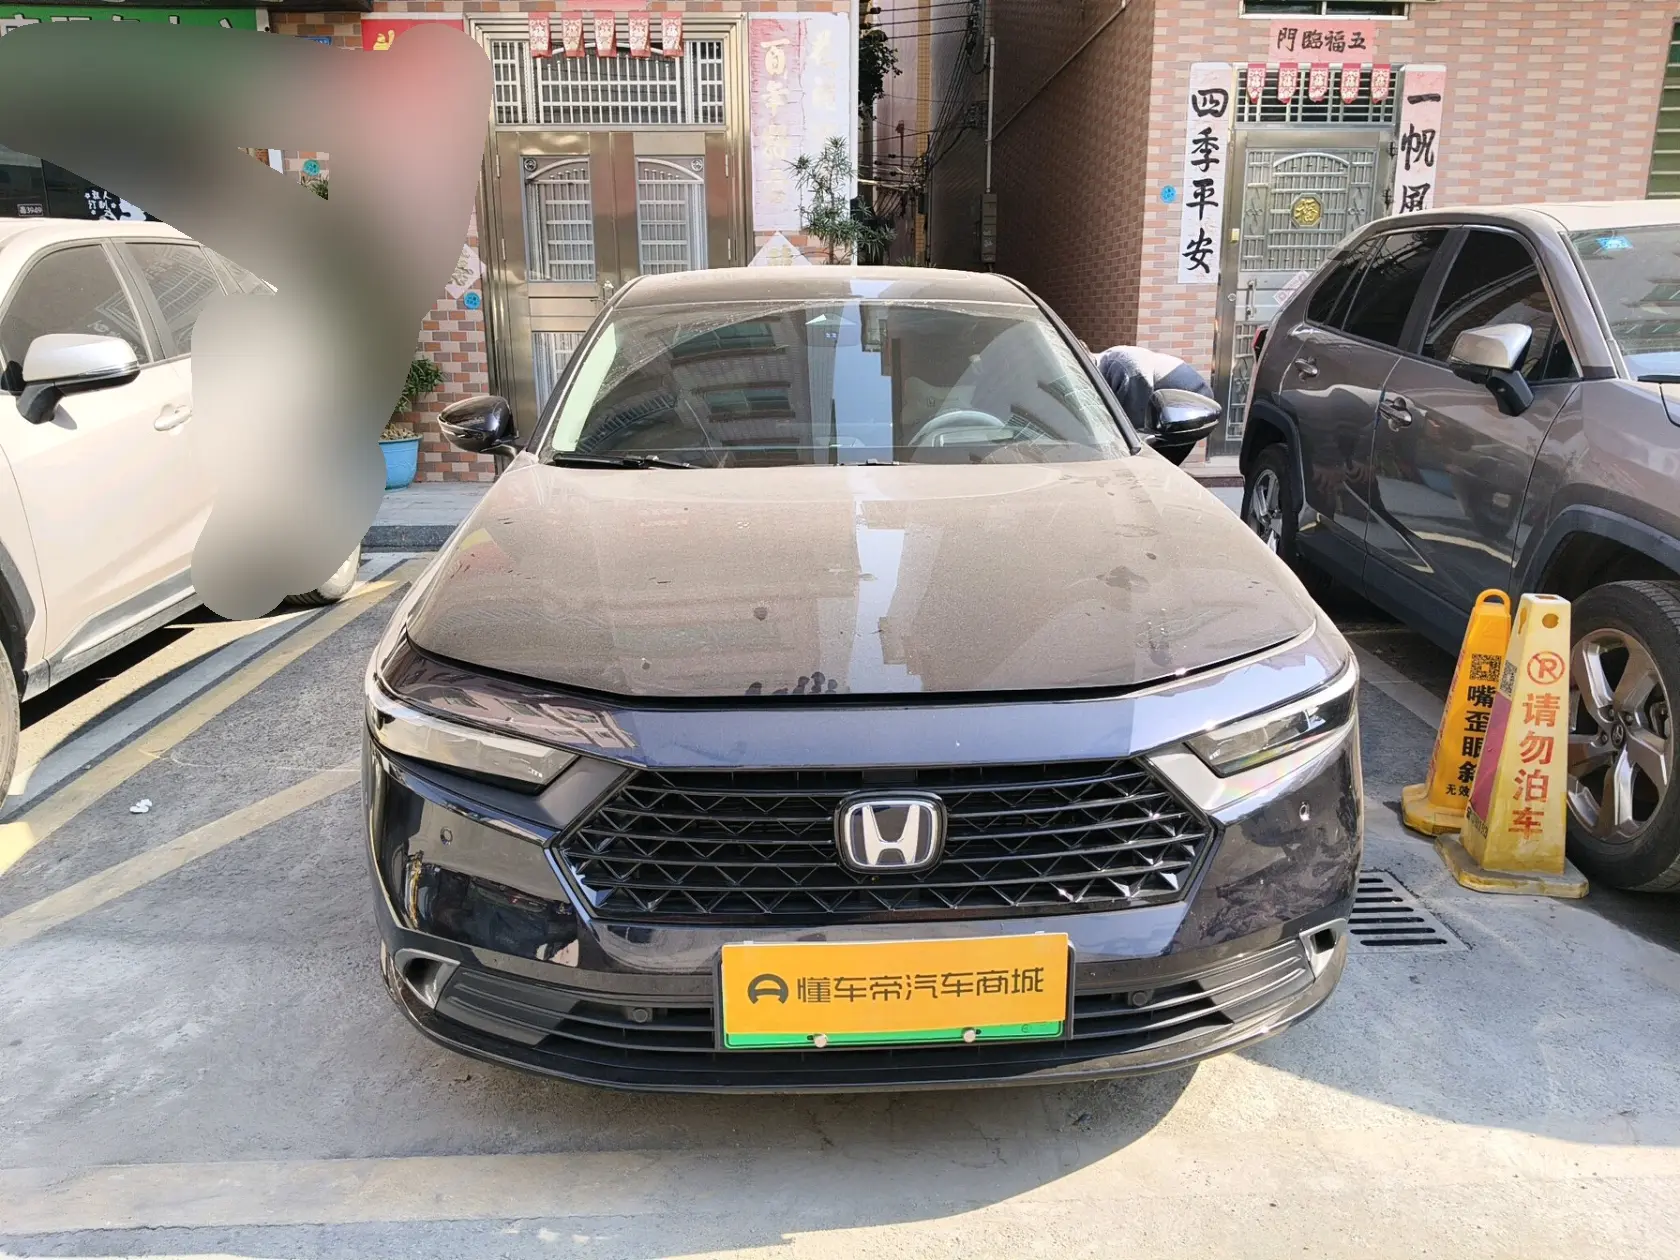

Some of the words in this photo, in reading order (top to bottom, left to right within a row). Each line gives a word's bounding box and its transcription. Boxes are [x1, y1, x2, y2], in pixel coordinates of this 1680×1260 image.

[1183, 88, 1229, 273] 四季平安
[1508, 692, 1561, 840] 请勿泊车
[797, 967, 1044, 1004] 懂车帝汽车商城
